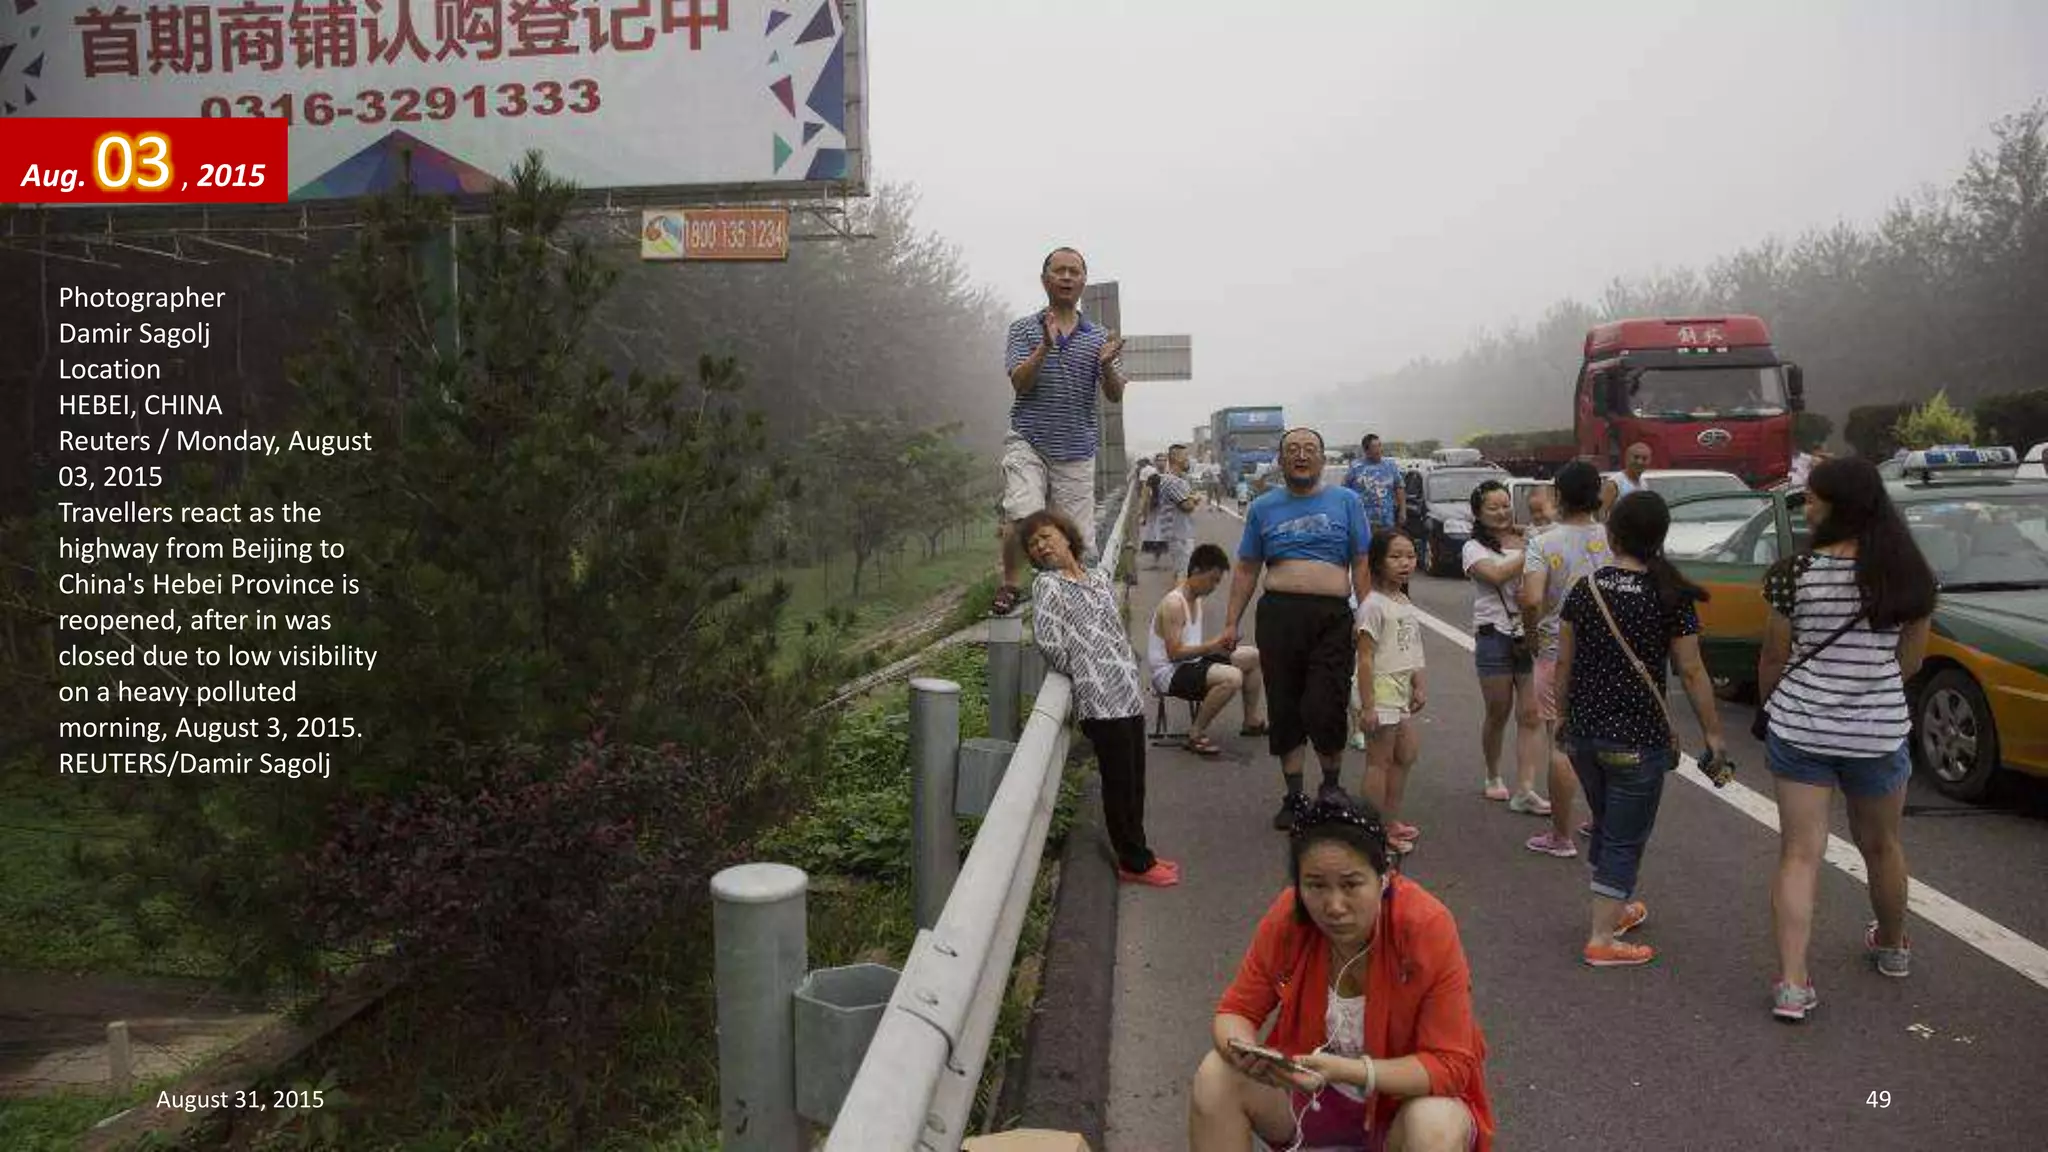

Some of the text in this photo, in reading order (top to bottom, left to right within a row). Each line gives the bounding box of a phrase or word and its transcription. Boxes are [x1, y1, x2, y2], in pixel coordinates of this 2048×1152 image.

[74, 0, 730, 79] 首期商铺认购登记中
[200, 78, 601, 127] 0316-3291333
